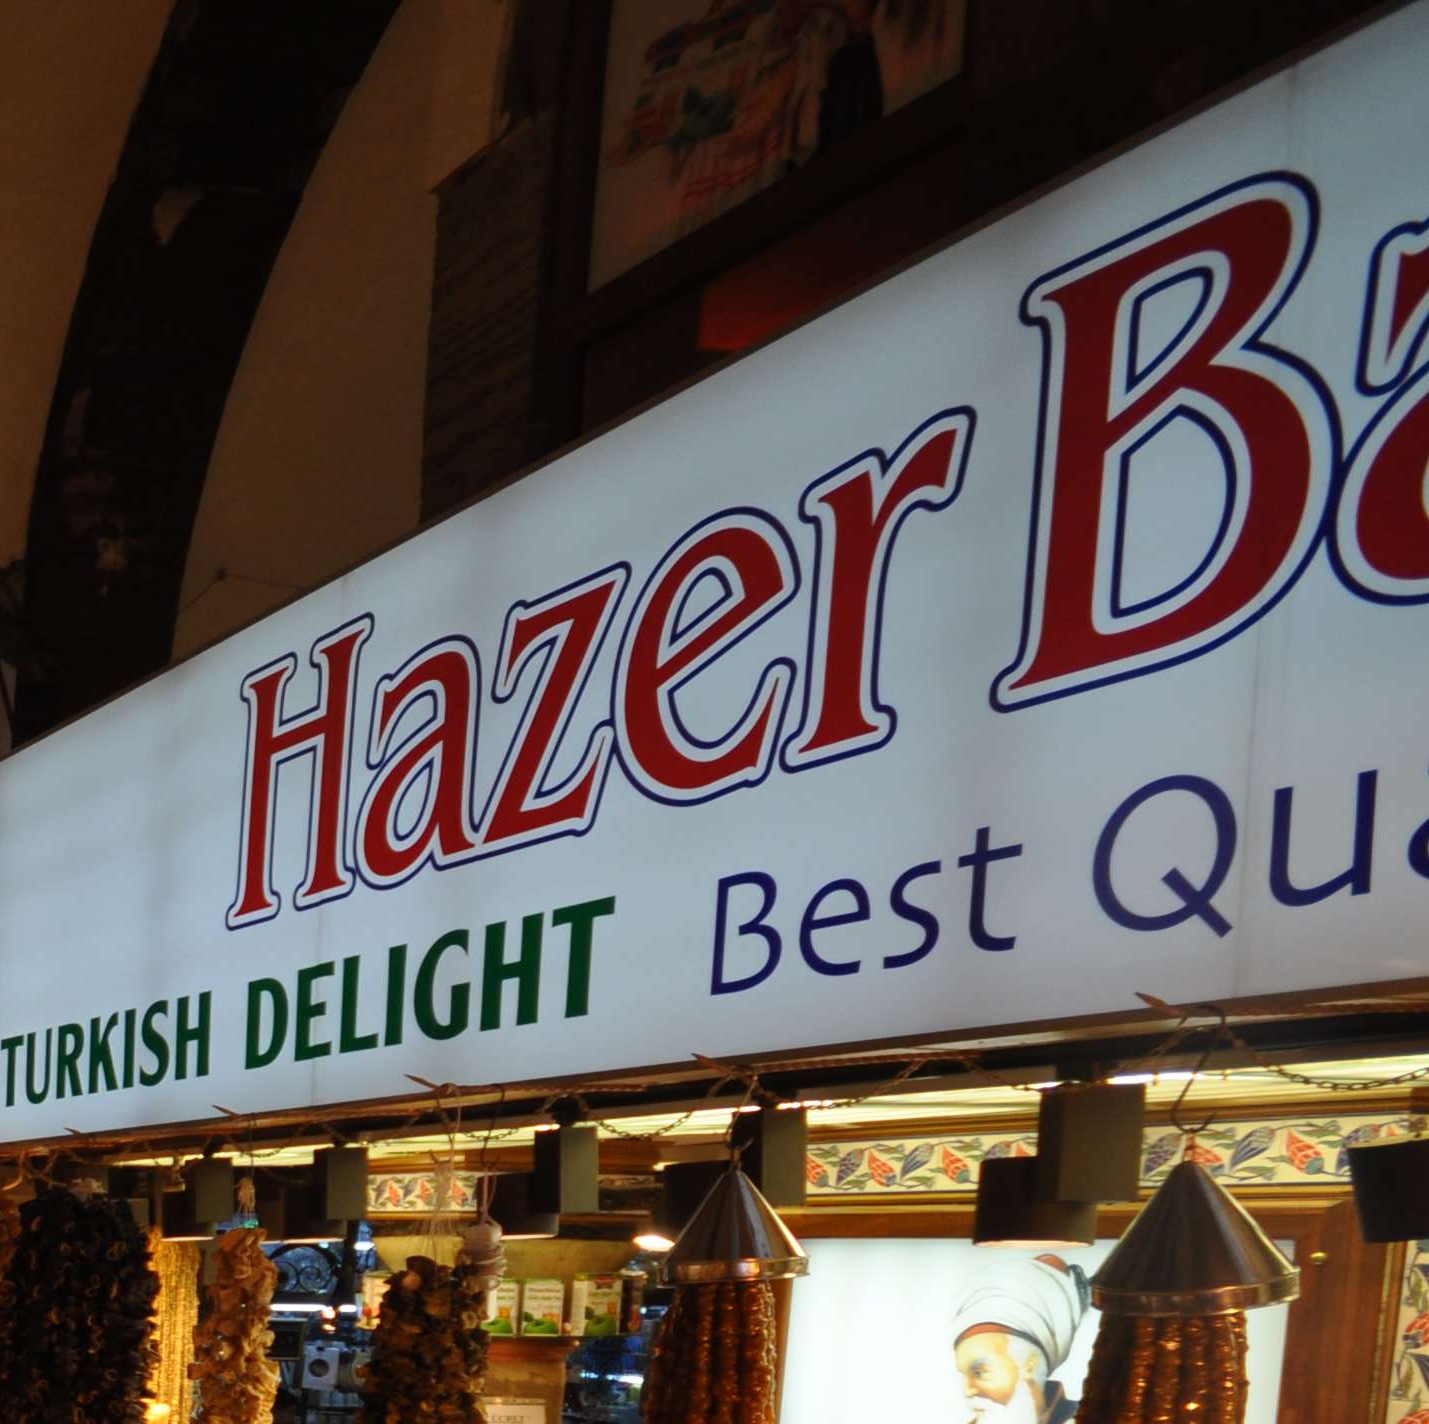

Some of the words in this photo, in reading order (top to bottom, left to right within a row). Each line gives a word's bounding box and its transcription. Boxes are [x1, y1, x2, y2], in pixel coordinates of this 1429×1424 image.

[226, 405, 976, 930] Hazer
[0, 992, 211, 1109] TURKISH
[245, 895, 615, 1069] DELIGHT
[709, 826, 1022, 995] Best
